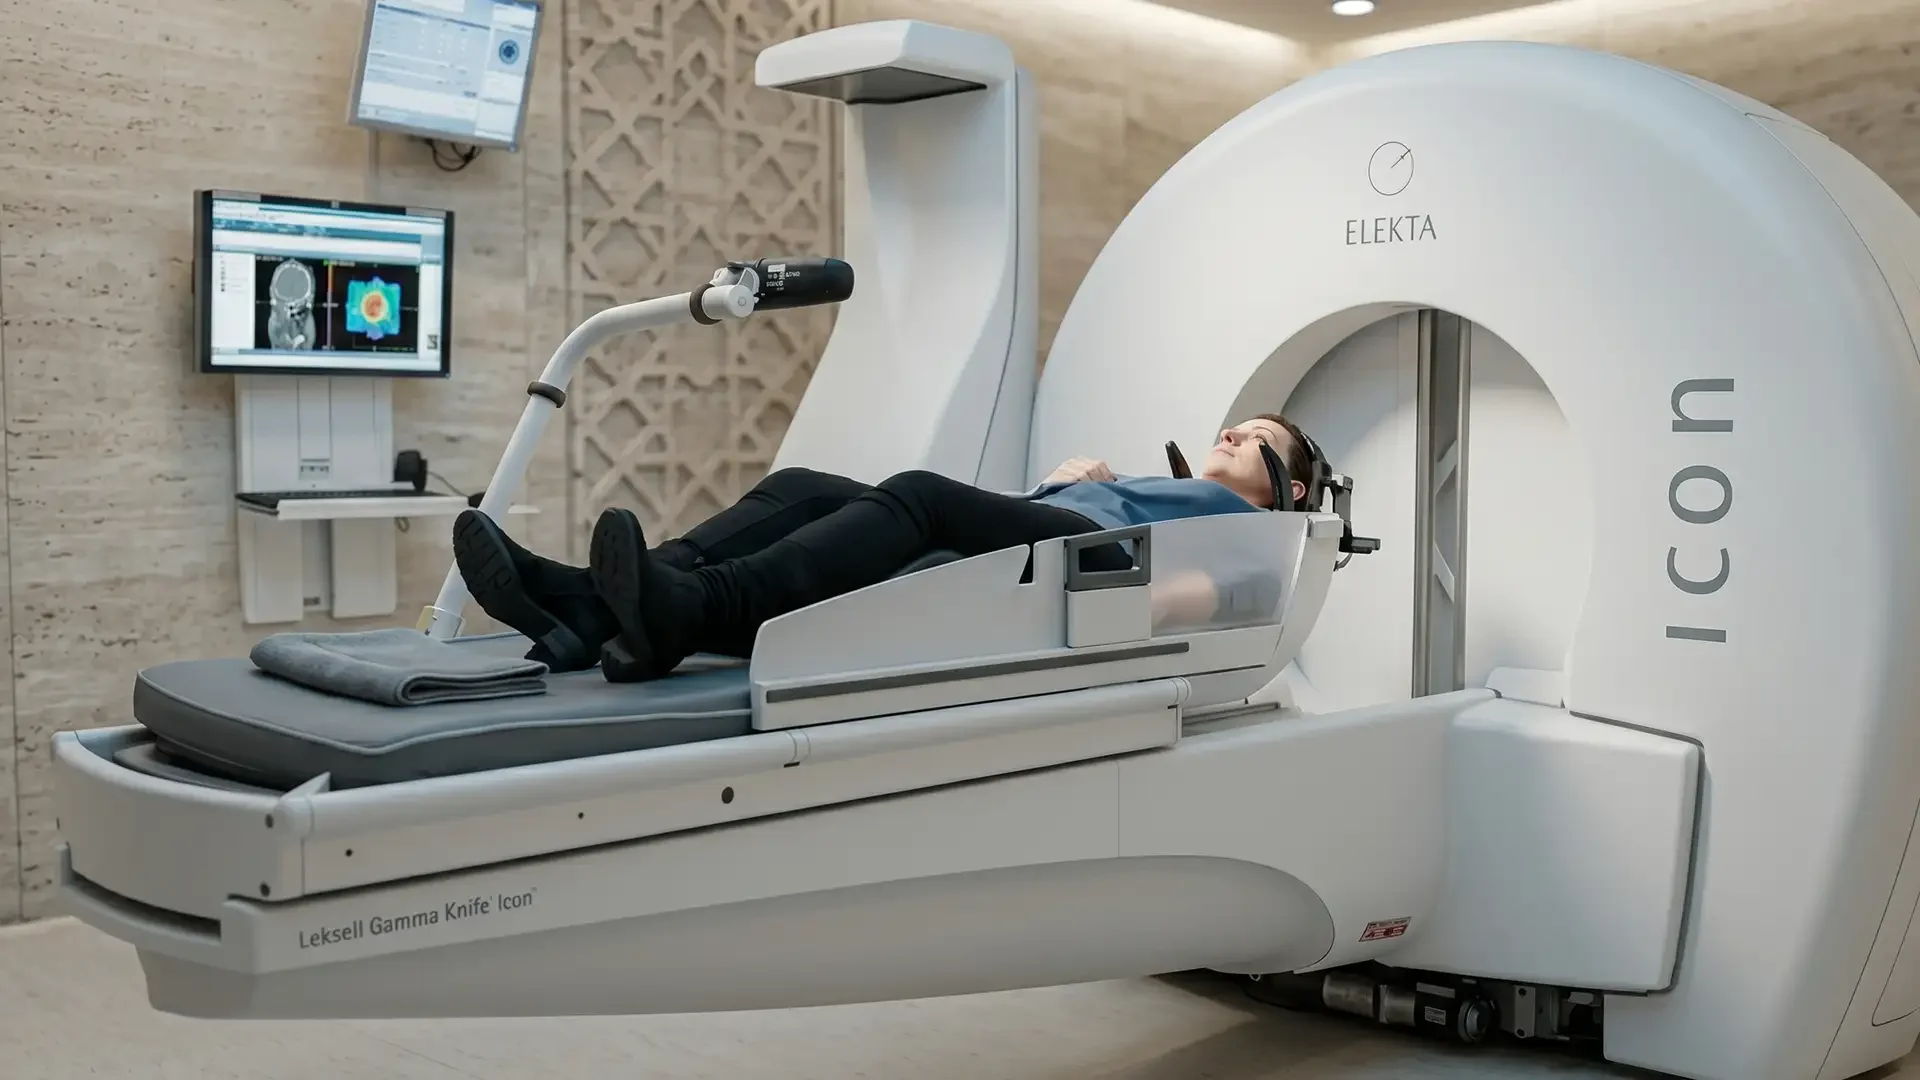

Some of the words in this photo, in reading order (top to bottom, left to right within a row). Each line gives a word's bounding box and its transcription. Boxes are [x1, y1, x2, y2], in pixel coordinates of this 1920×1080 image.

[1346, 214, 1437, 246] ELEKTA
[1666, 378, 1735, 643] Icon
[299, 919, 364, 949] Leksell
[369, 909, 439, 936] Gamma
